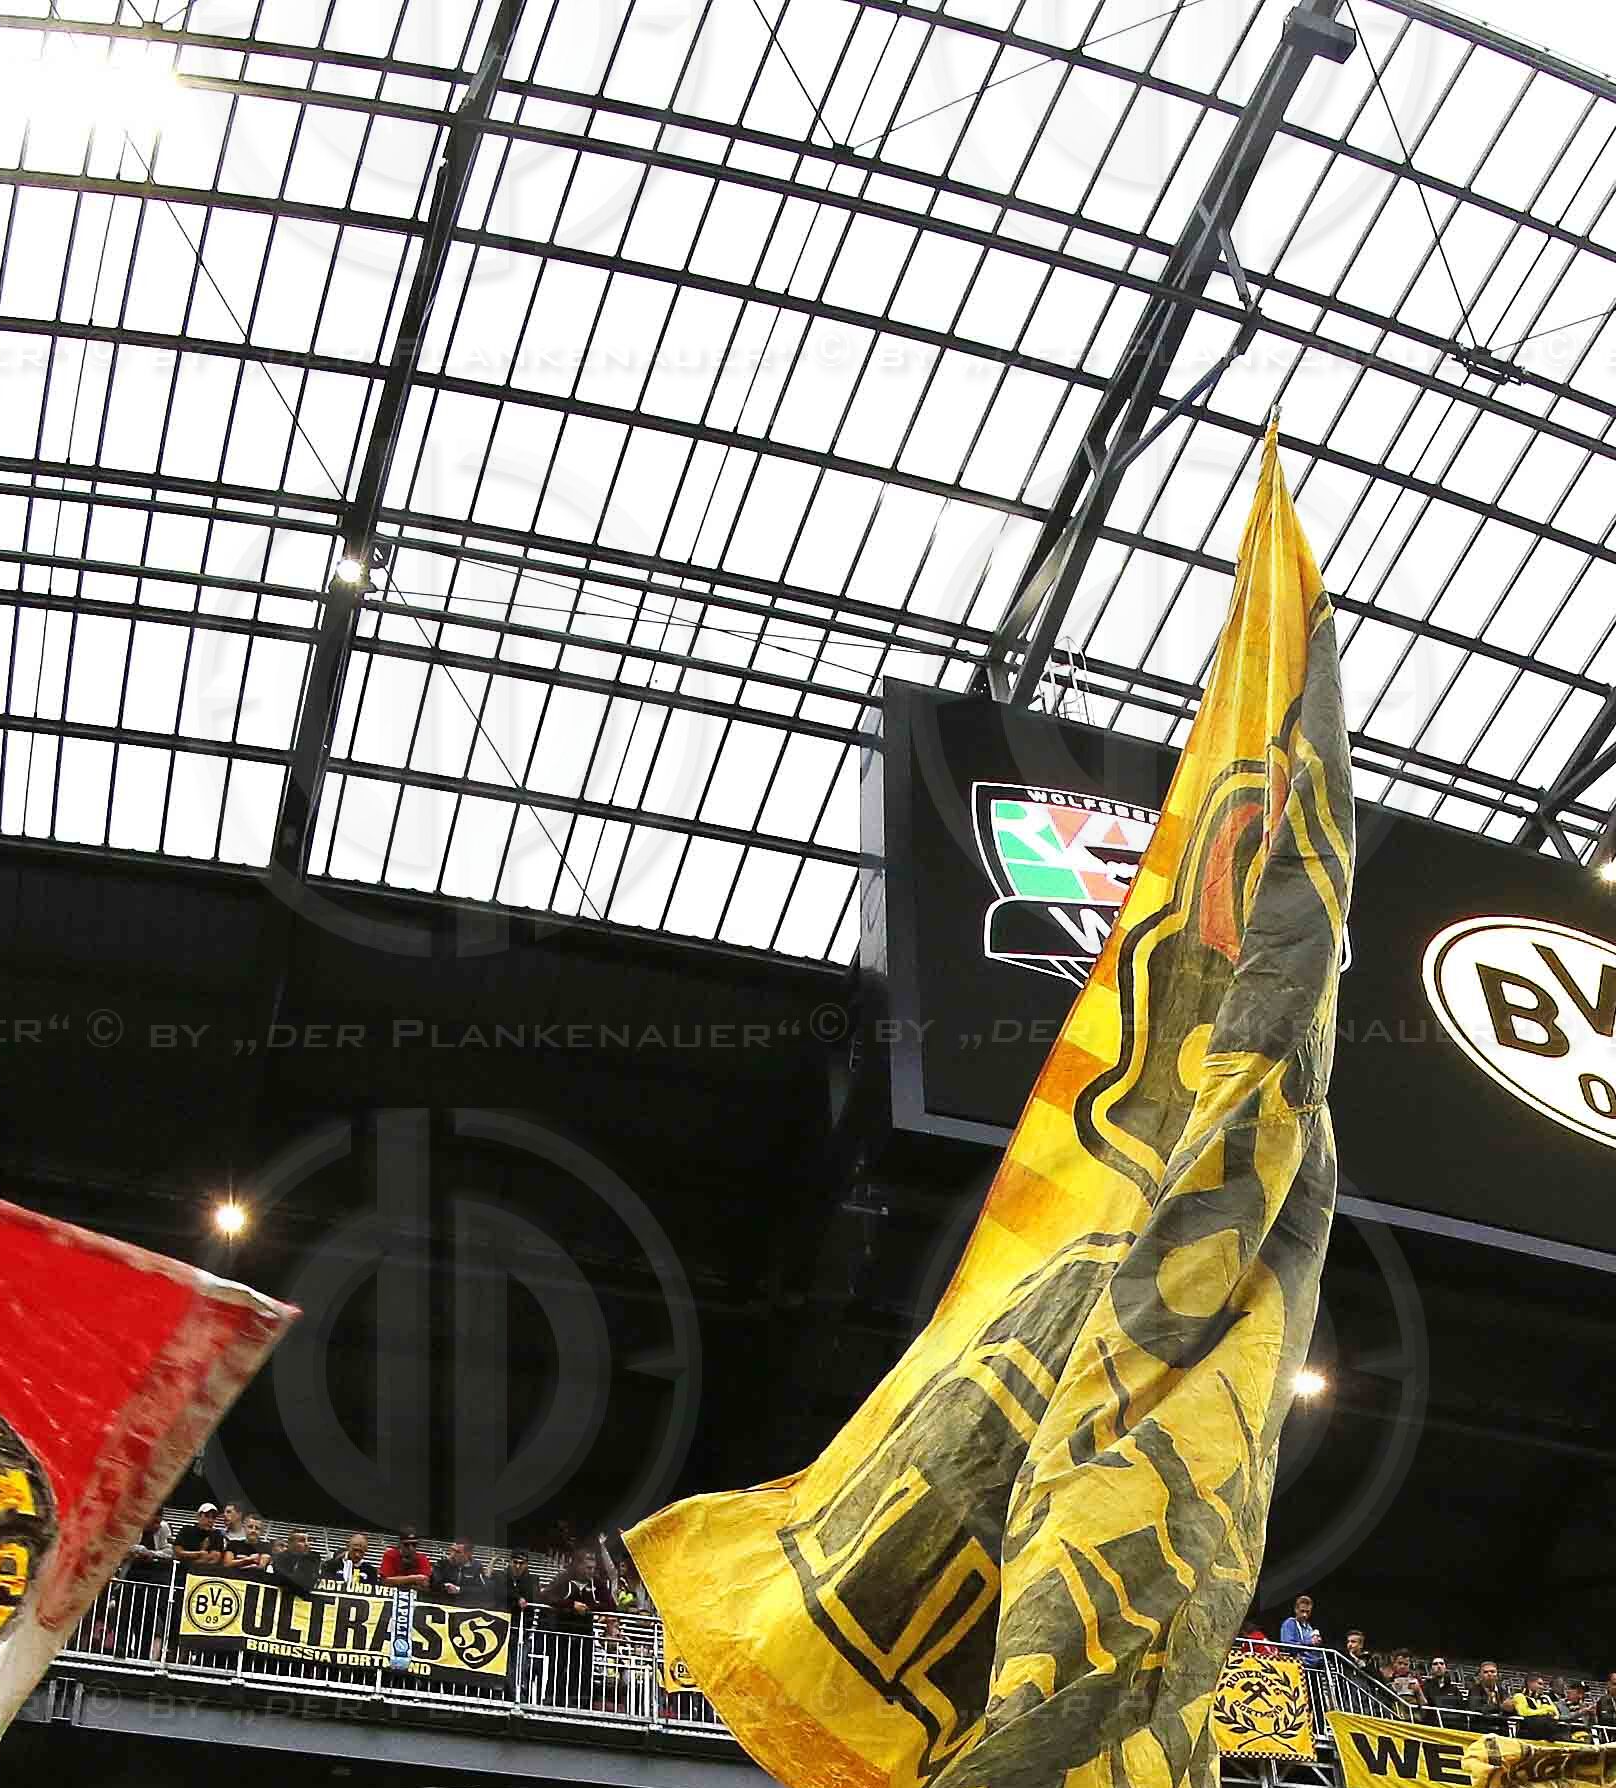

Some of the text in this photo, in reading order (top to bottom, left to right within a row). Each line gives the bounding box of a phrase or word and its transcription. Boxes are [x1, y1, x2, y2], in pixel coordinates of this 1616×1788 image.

[195, 1587, 234, 1616] BVB
[396, 1590, 411, 1638] NAPOLI
[241, 1586, 447, 1662] ULTRAS
[246, 1638, 333, 1665] BORUSSIA
